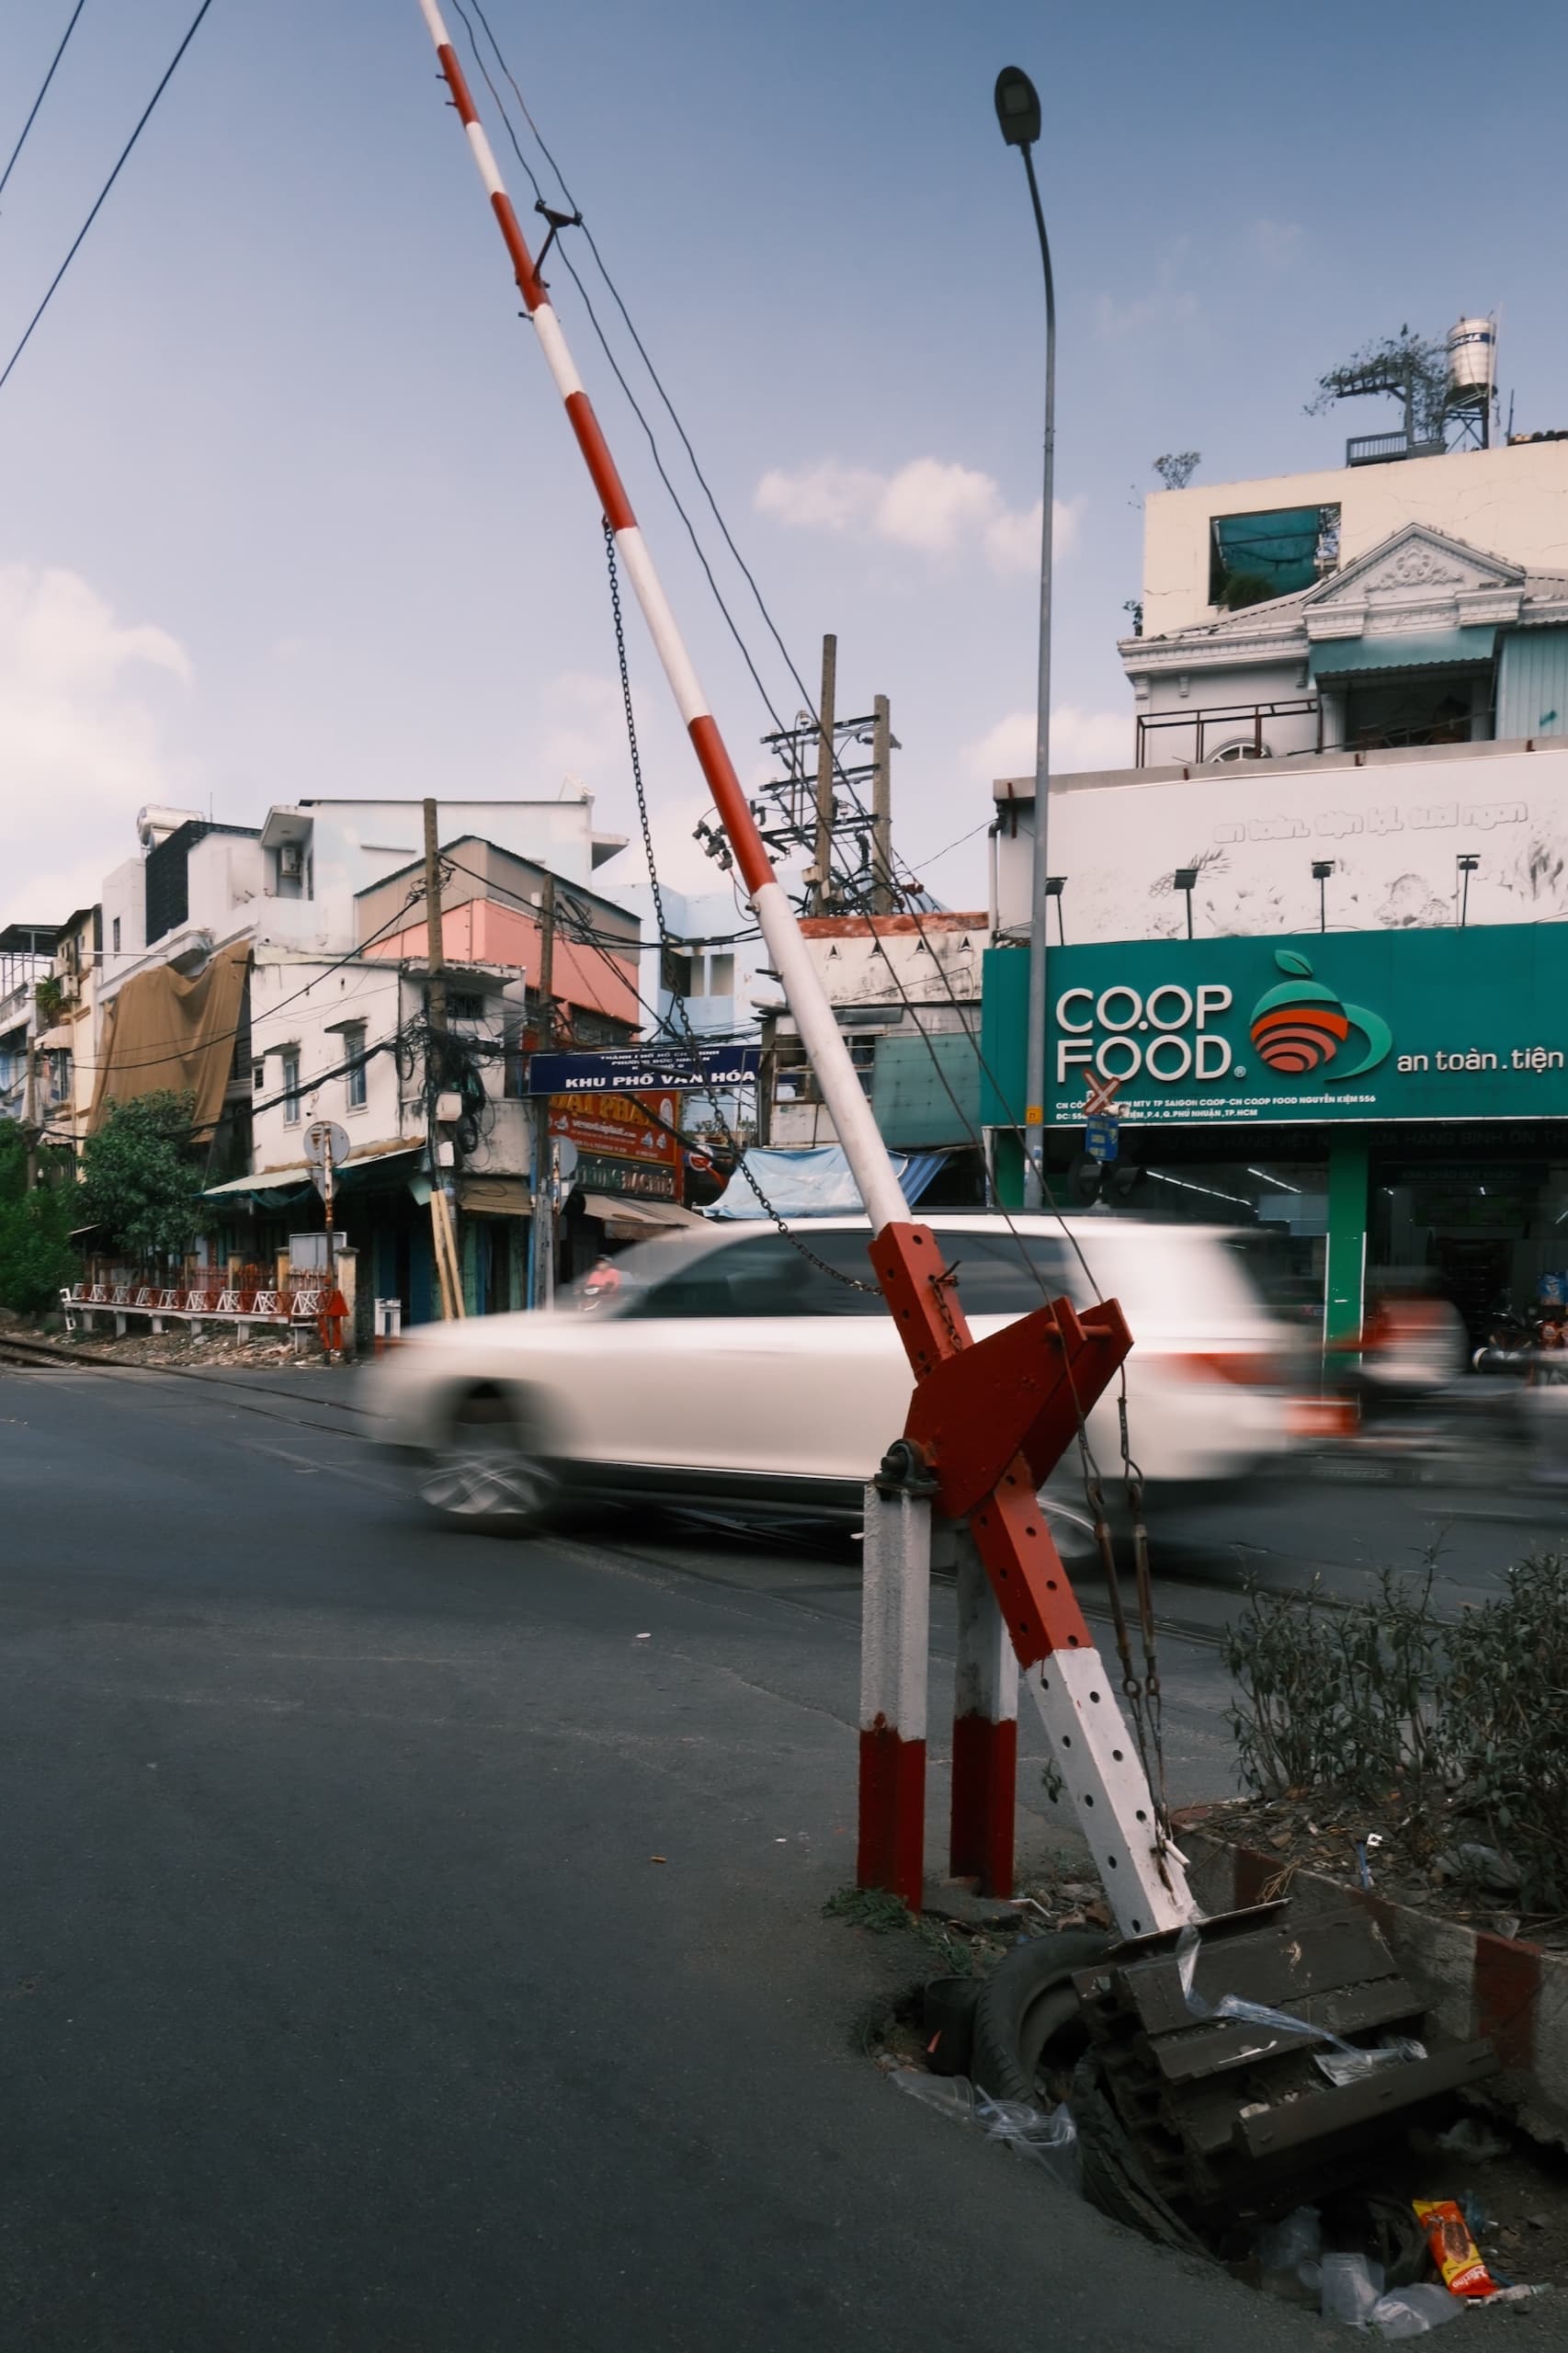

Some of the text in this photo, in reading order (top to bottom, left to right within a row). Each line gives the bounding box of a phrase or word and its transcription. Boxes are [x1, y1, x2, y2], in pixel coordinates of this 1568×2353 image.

[1056, 984, 1233, 1033] CO.OP
[1057, 1034, 1233, 1083] FOOD
[1397, 1054, 1428, 1072] an
[1511, 1046, 1564, 1074] tiện
[565, 1077, 606, 1088] KHU
[612, 1071, 654, 1086] PHỐ
[710, 1069, 756, 1083] HÓA
[1272, 1097, 1298, 1105] FOOD
